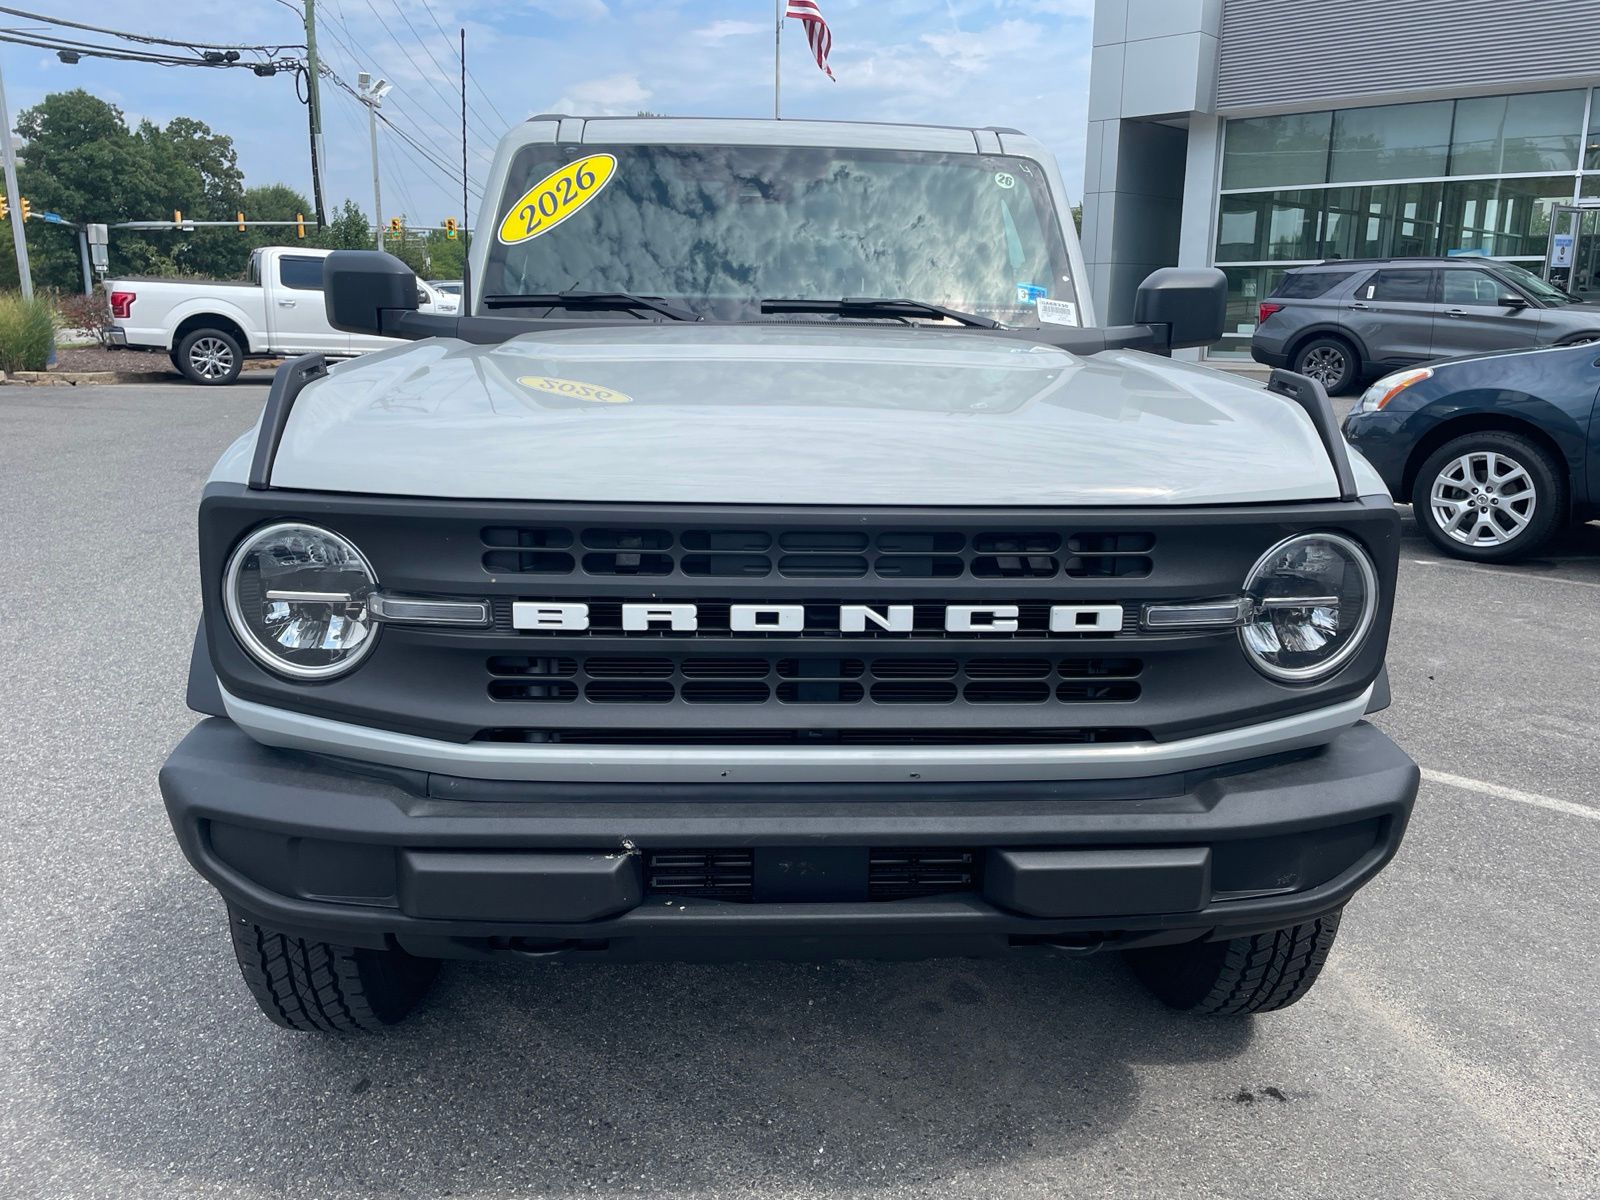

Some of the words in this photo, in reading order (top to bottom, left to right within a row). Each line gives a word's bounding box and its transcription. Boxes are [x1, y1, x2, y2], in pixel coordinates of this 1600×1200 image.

[997, 174, 1013, 186] 26
[519, 161, 596, 235] 2026
[512, 601, 1124, 633] BRONCO
